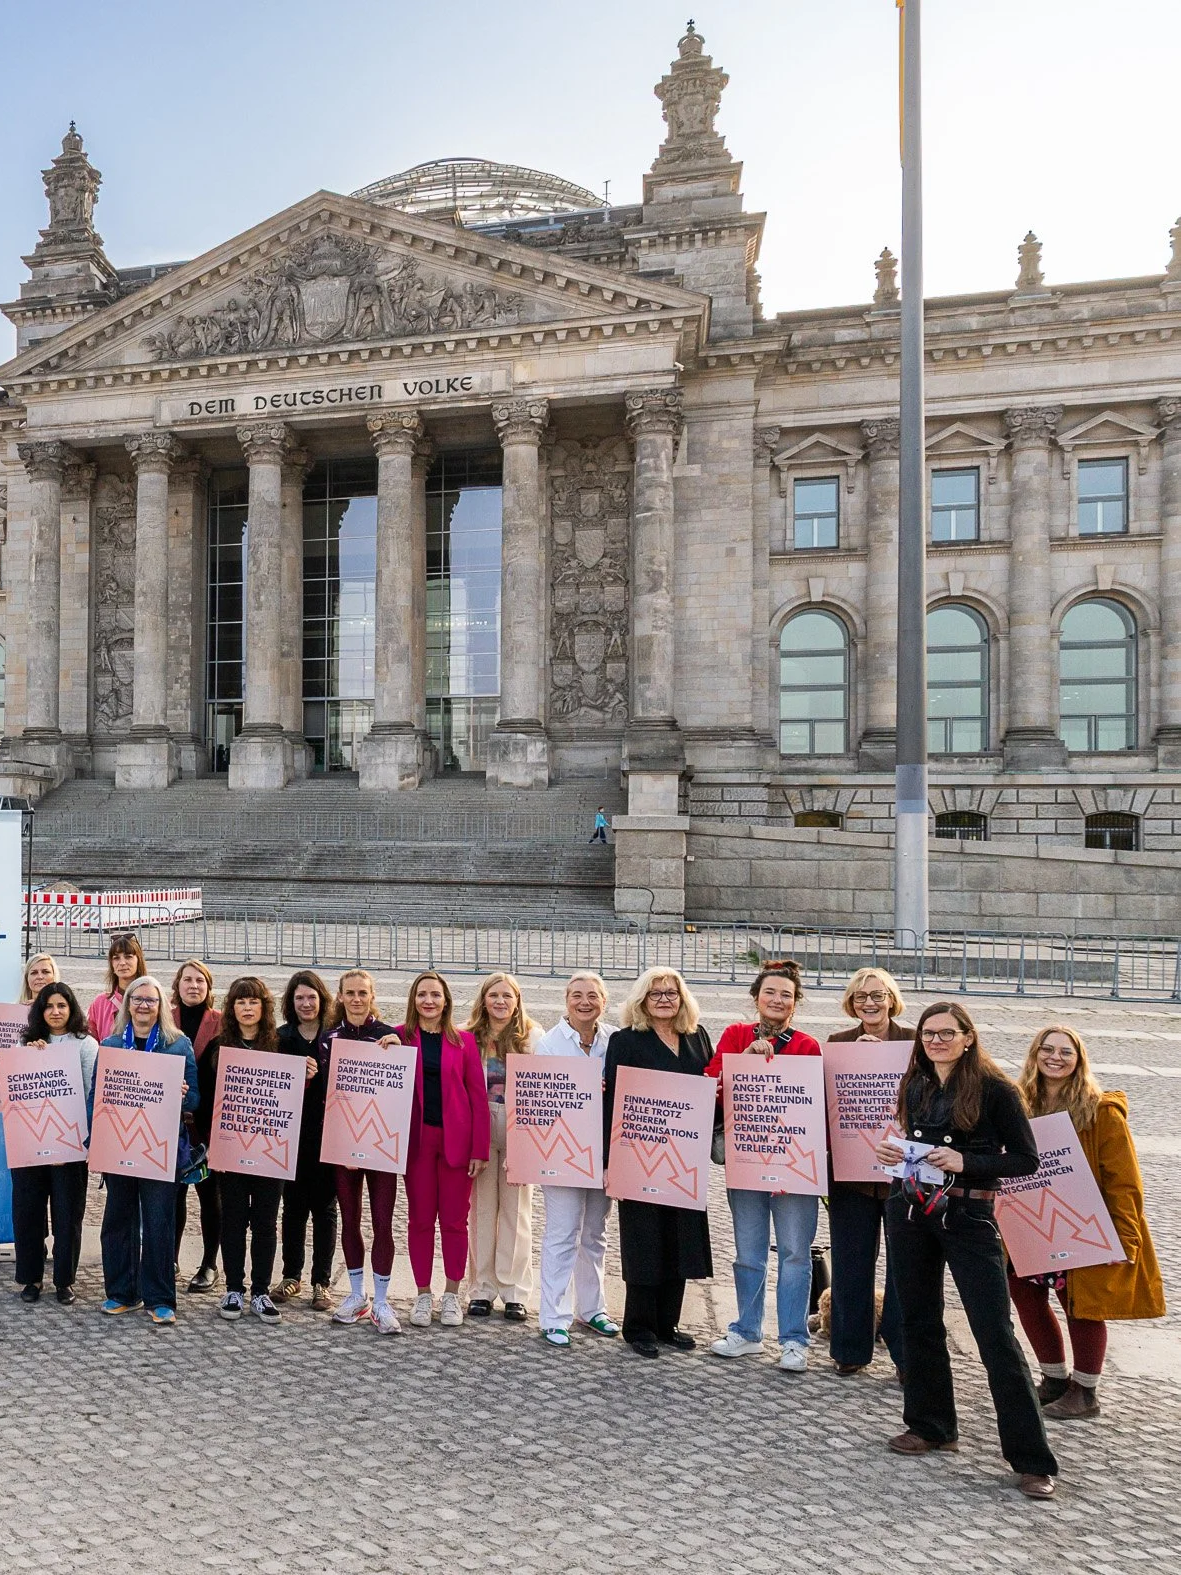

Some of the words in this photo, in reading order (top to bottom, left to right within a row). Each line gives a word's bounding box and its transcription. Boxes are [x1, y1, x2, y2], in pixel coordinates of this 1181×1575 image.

[189, 399, 235, 416] DEM
[254, 384, 382, 410] DEUTSCHEN
[403, 377, 473, 396] VOLKE
[339, 1058, 407, 1071] SCHWANGERSCHAFT
[8, 1070, 67, 1082] SCHWANGER.
[113, 1070, 140, 1078] MONAT.
[226, 1065, 295, 1080] SCHAUSPIELER-
[360, 1069, 384, 1077] NICHT
[9, 1079, 70, 1092] SELBSTÄNDIG.
[104, 1076, 142, 1086] BAUSTELLE.
[225, 1075, 253, 1084] INNEN
[255, 1079, 290, 1090] SPIELEN
[337, 1075, 384, 1086] SPORTLICHE
[9, 1087, 76, 1101] UNGESCHÜTZT.
[104, 1084, 151, 1094] ABSICHERUNG
[224, 1084, 243, 1093] IHRE
[246, 1088, 276, 1099] ROLLE,
[336, 1083, 377, 1094] BEDEUTEN.
[733, 1084, 766, 1092] ANGST
[124, 1093, 162, 1103] NOCHMAL?
[223, 1094, 248, 1103] AUCH
[251, 1097, 278, 1107] WENN
[546, 1090, 574, 1099] HÄTTE
[733, 1094, 760, 1102] BESTE
[764, 1096, 812, 1104] FREUNDIN
[103, 1098, 145, 1109] UNDENKBAR.
[532, 1100, 583, 1109] INSOLVENZ
[624, 1095, 694, 1110] EINNAHMEAUS-
[222, 1103, 293, 1119] MUTTERSCHUTZ
[516, 1108, 561, 1117] RISKIEREN
[623, 1102, 649, 1114] FÄLLE
[652, 1108, 681, 1118] TROTZ
[237, 1115, 260, 1124] EUCH
[263, 1119, 288, 1128] KEINE
[516, 1117, 555, 1126] SOLLEN?
[623, 1112, 666, 1125] HÖHEREM
[734, 1114, 778, 1123] UNSEREN
[220, 1122, 247, 1132] ROLLE
[250, 1126, 281, 1137] SPIELT.
[622, 1122, 698, 1139] ORGANISATIONS
[734, 1124, 805, 1134] GEMEINSAMEN
[621, 1131, 668, 1144] AUFWAND
[734, 1134, 768, 1142] TRAUM
[734, 1144, 785, 1154] VERLIEREN
[1040, 1147, 1071, 1160] SCHAFT
[1000, 1166, 1073, 1186] ARRIERECHANCEN
[997, 1180, 1051, 1196] ENTSCHEIDEN
